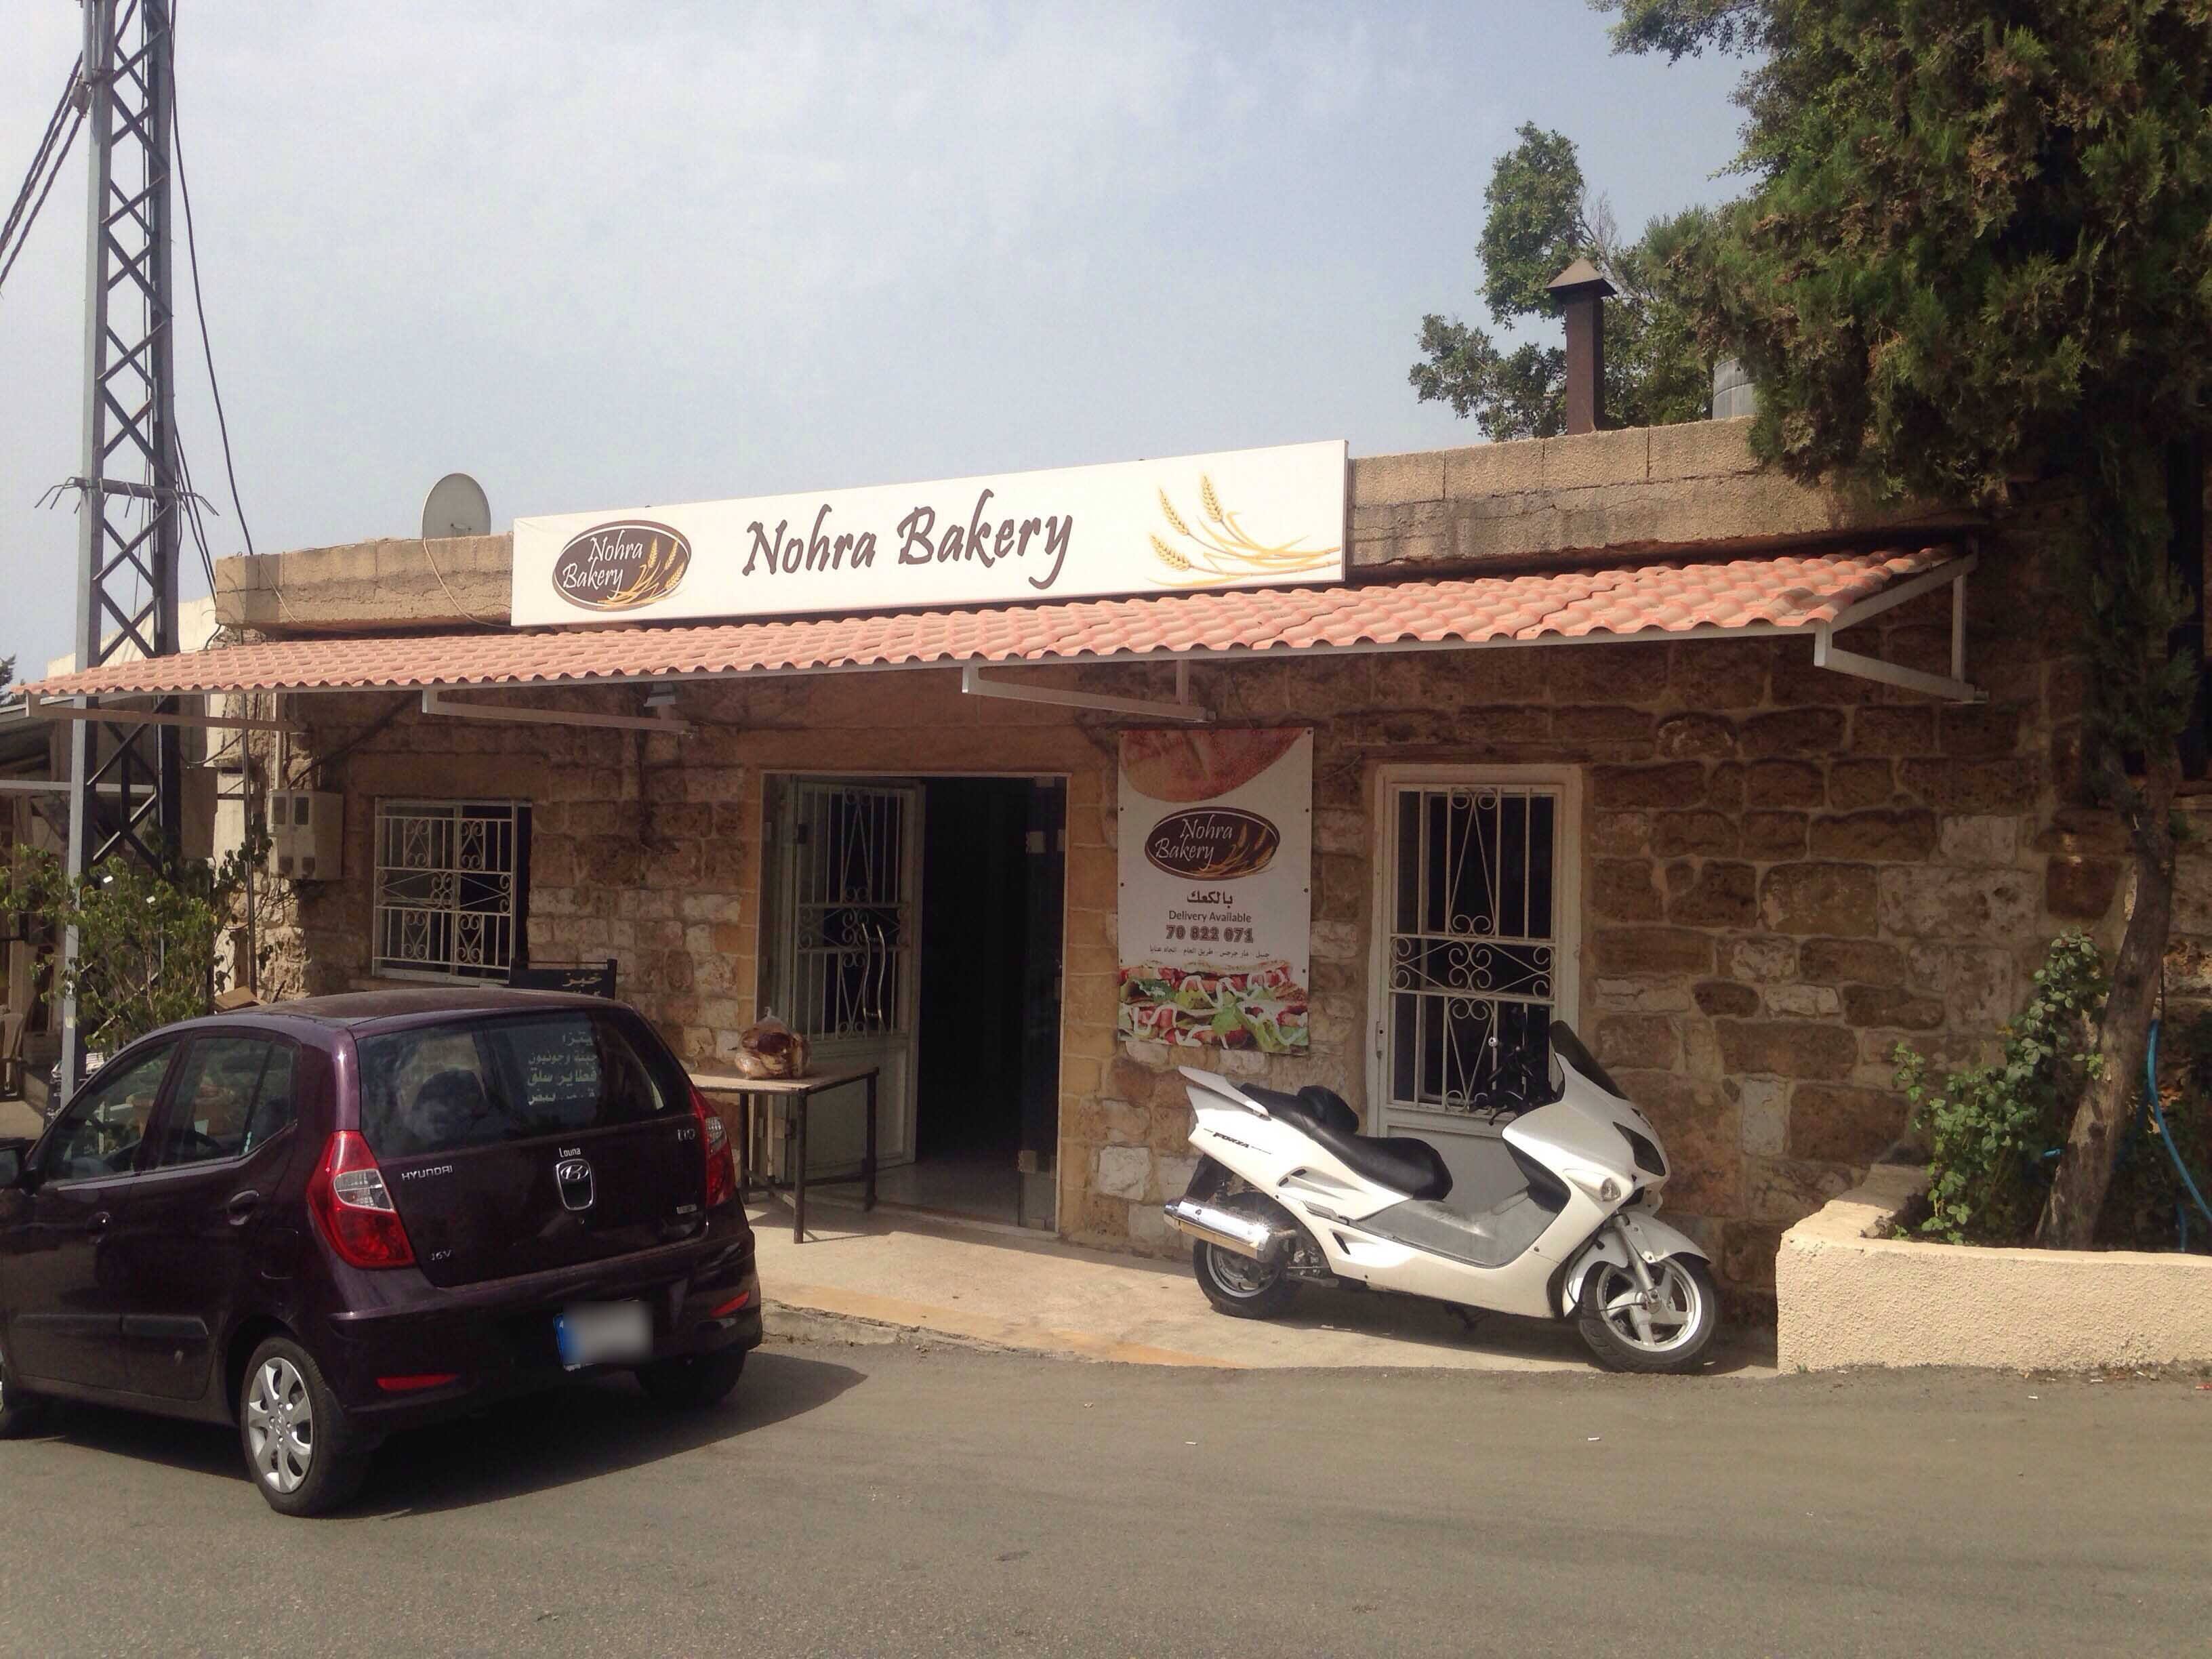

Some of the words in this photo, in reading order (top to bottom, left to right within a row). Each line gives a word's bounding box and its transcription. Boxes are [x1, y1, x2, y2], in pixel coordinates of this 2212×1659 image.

[588, 530, 643, 562] Nohra
[742, 504, 877, 576] Nohra
[897, 489, 1073, 590] Bakery
[562, 556, 623, 600] Bakery
[1180, 814, 1233, 839] Nohra
[1155, 834, 1214, 872] Bakery
[1187, 890, 1233, 909] بالكعك
[1168, 910, 1207, 922] Delivery
[1209, 912, 1252, 923] Available
[1165, 924, 1186, 940] 70
[1190, 926, 1220, 941] 822
[1223, 926, 1254, 943] 071
[1212, 1132, 1250, 1149] FORZA
[401, 1165, 453, 1181] HYUNDAI
